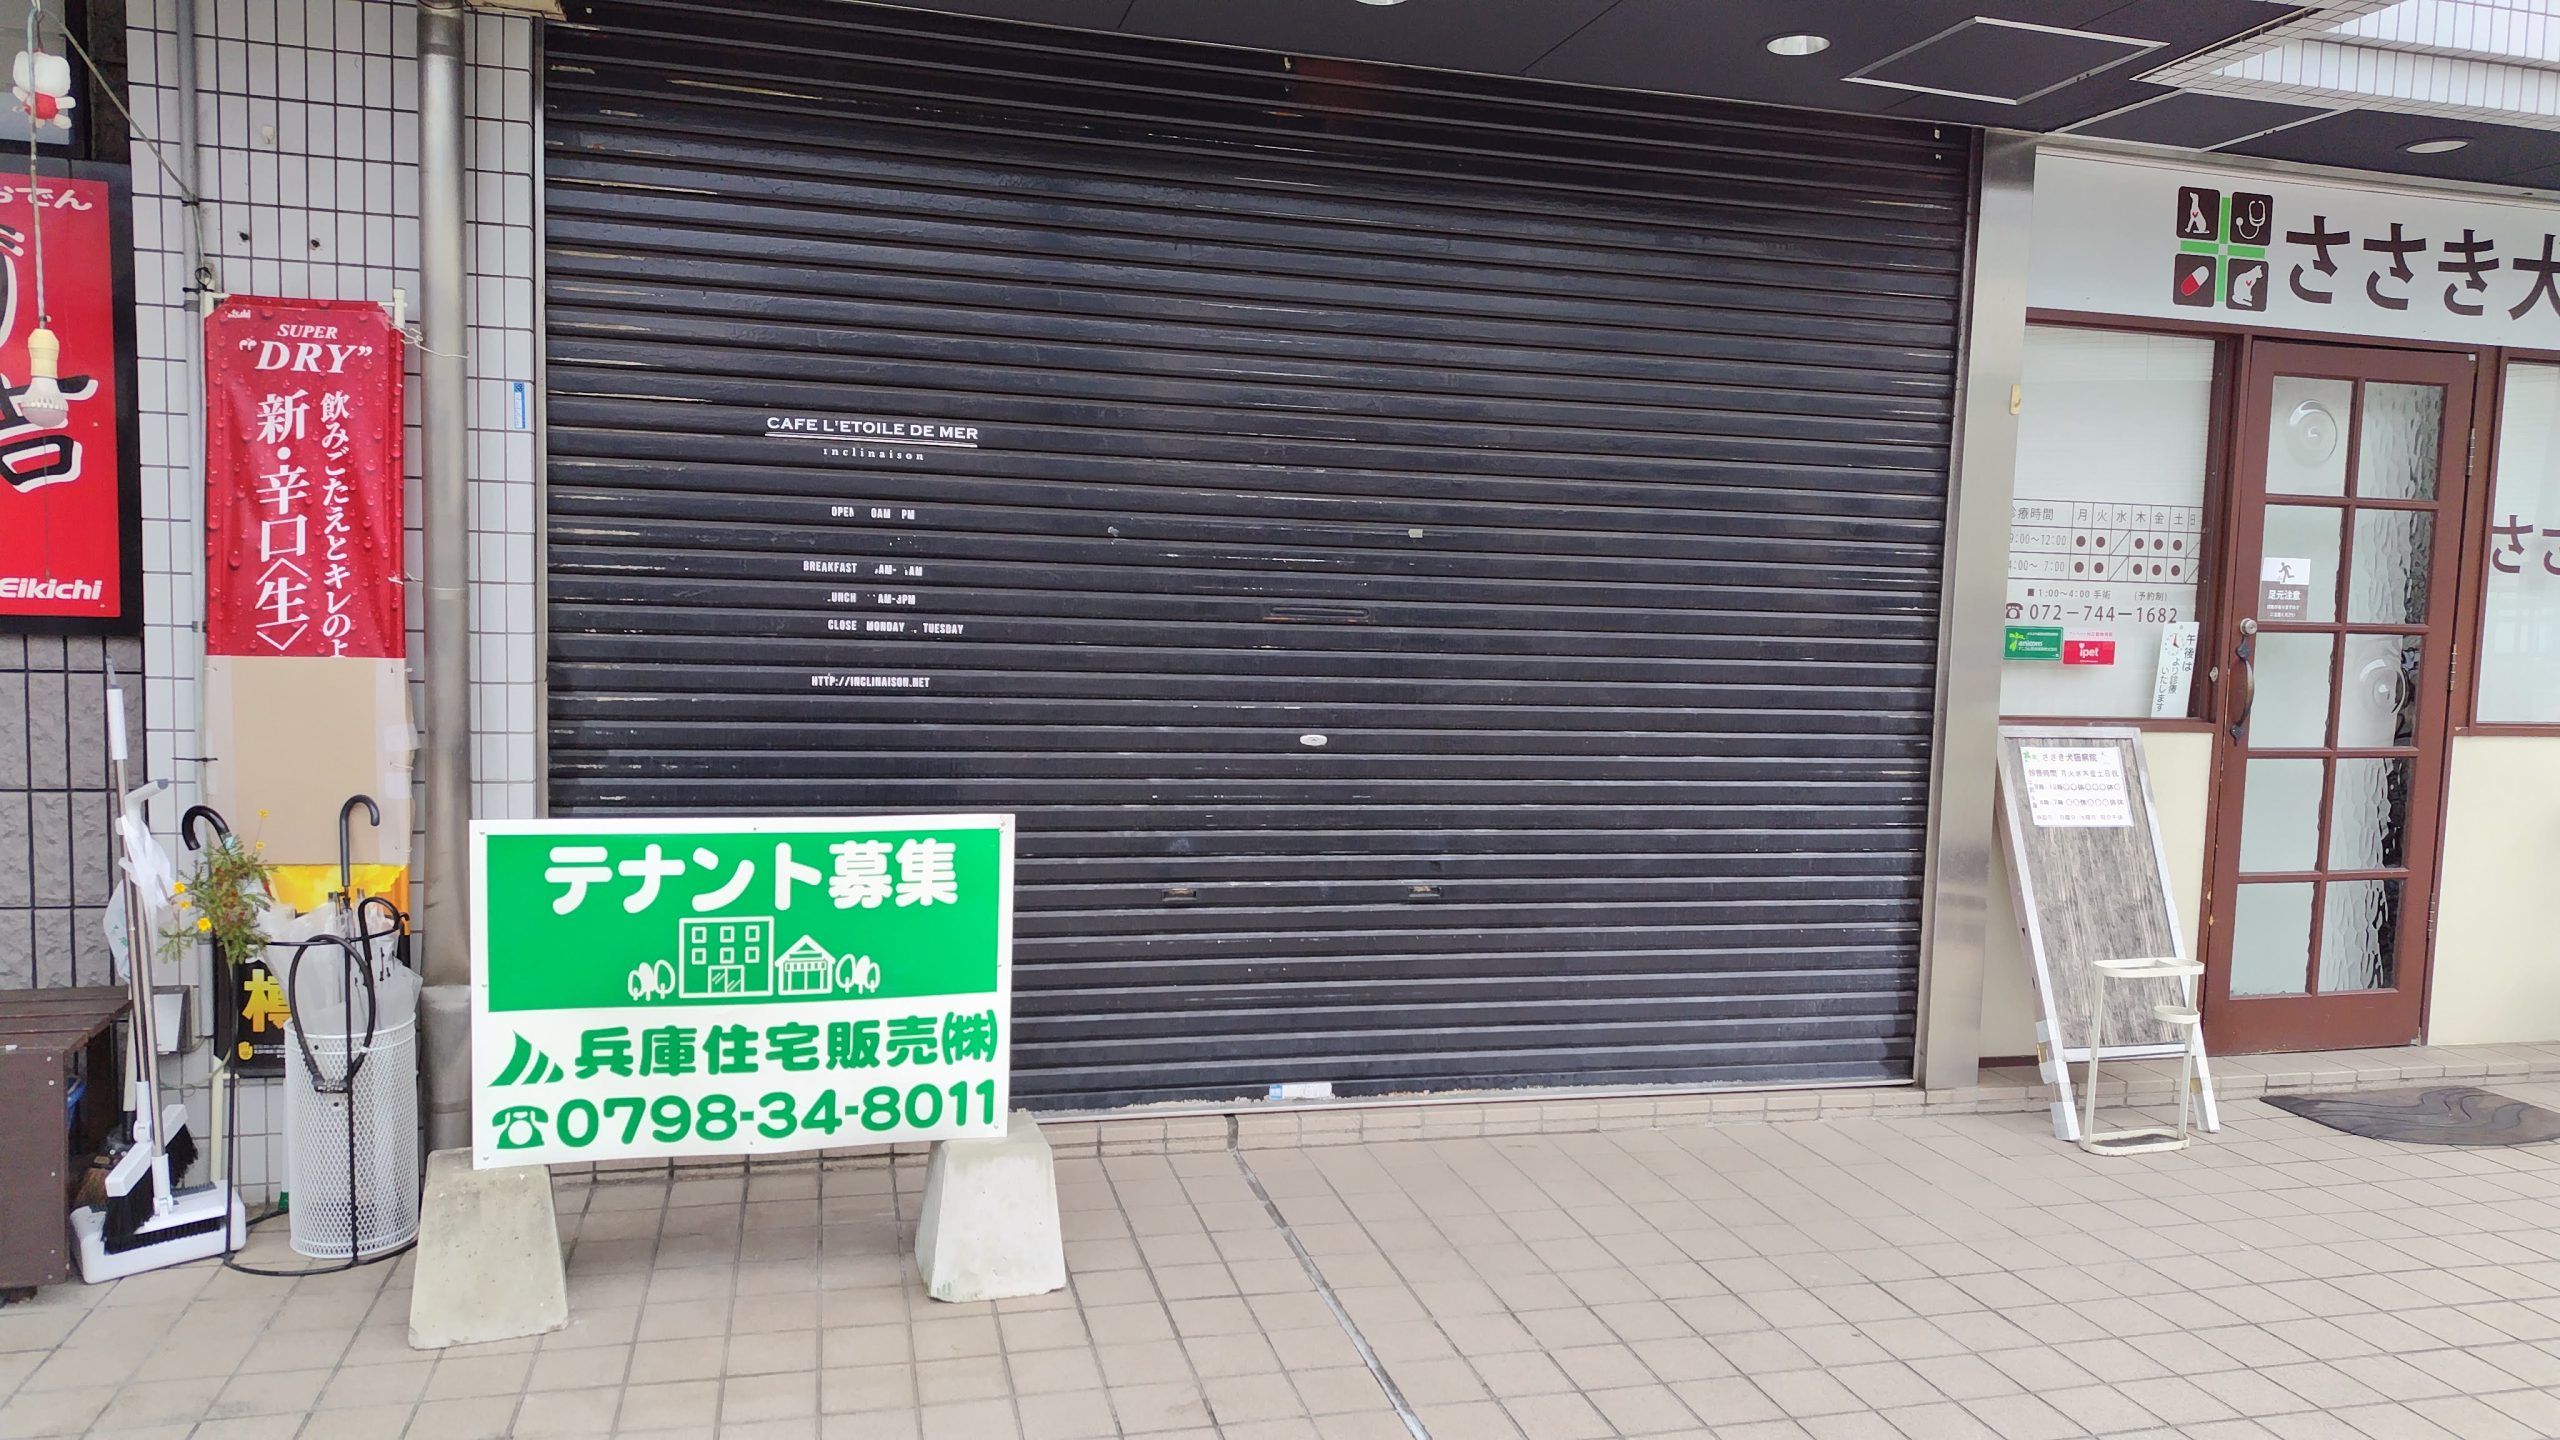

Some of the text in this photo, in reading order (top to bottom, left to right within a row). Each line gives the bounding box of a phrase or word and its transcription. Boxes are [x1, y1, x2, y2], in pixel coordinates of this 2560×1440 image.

[277, 323, 338, 339] SUPER
[766, 417, 978, 440] CAFE L'ETOILE DE MER
[823, 447, 924, 461] inclinaison
[901, 509, 915, 520] PM
[2077, 508, 2088, 521] 月
[2096, 509, 2108, 521] 火
[2116, 510, 2128, 522] 水
[2135, 511, 2147, 523] 木
[2154, 511, 2165, 525] 金
[2174, 513, 2185, 526] 土
[803, 560, 857, 574] BREAKFAST
[0, 577, 103, 601] Eikichi
[827, 591, 857, 603] UNCH
[2093, 590, 2111, 600] 手術
[2267, 589, 2301, 601] 足元注意
[827, 619, 964, 635] CLOSE MONDAY TUESDAY
[2079, 643, 2099, 658] ipet
[2182, 634, 2196, 672] 午後は
[811, 675, 930, 689] HTTP://INCLINAISON.NET
[2156, 667, 2170, 711] いたします
[544, 837, 958, 917] テナント募集
[574, 1009, 998, 1081] 兵庫住宅販売(株)
[556, 1078, 995, 1149] 0798-34-8011
